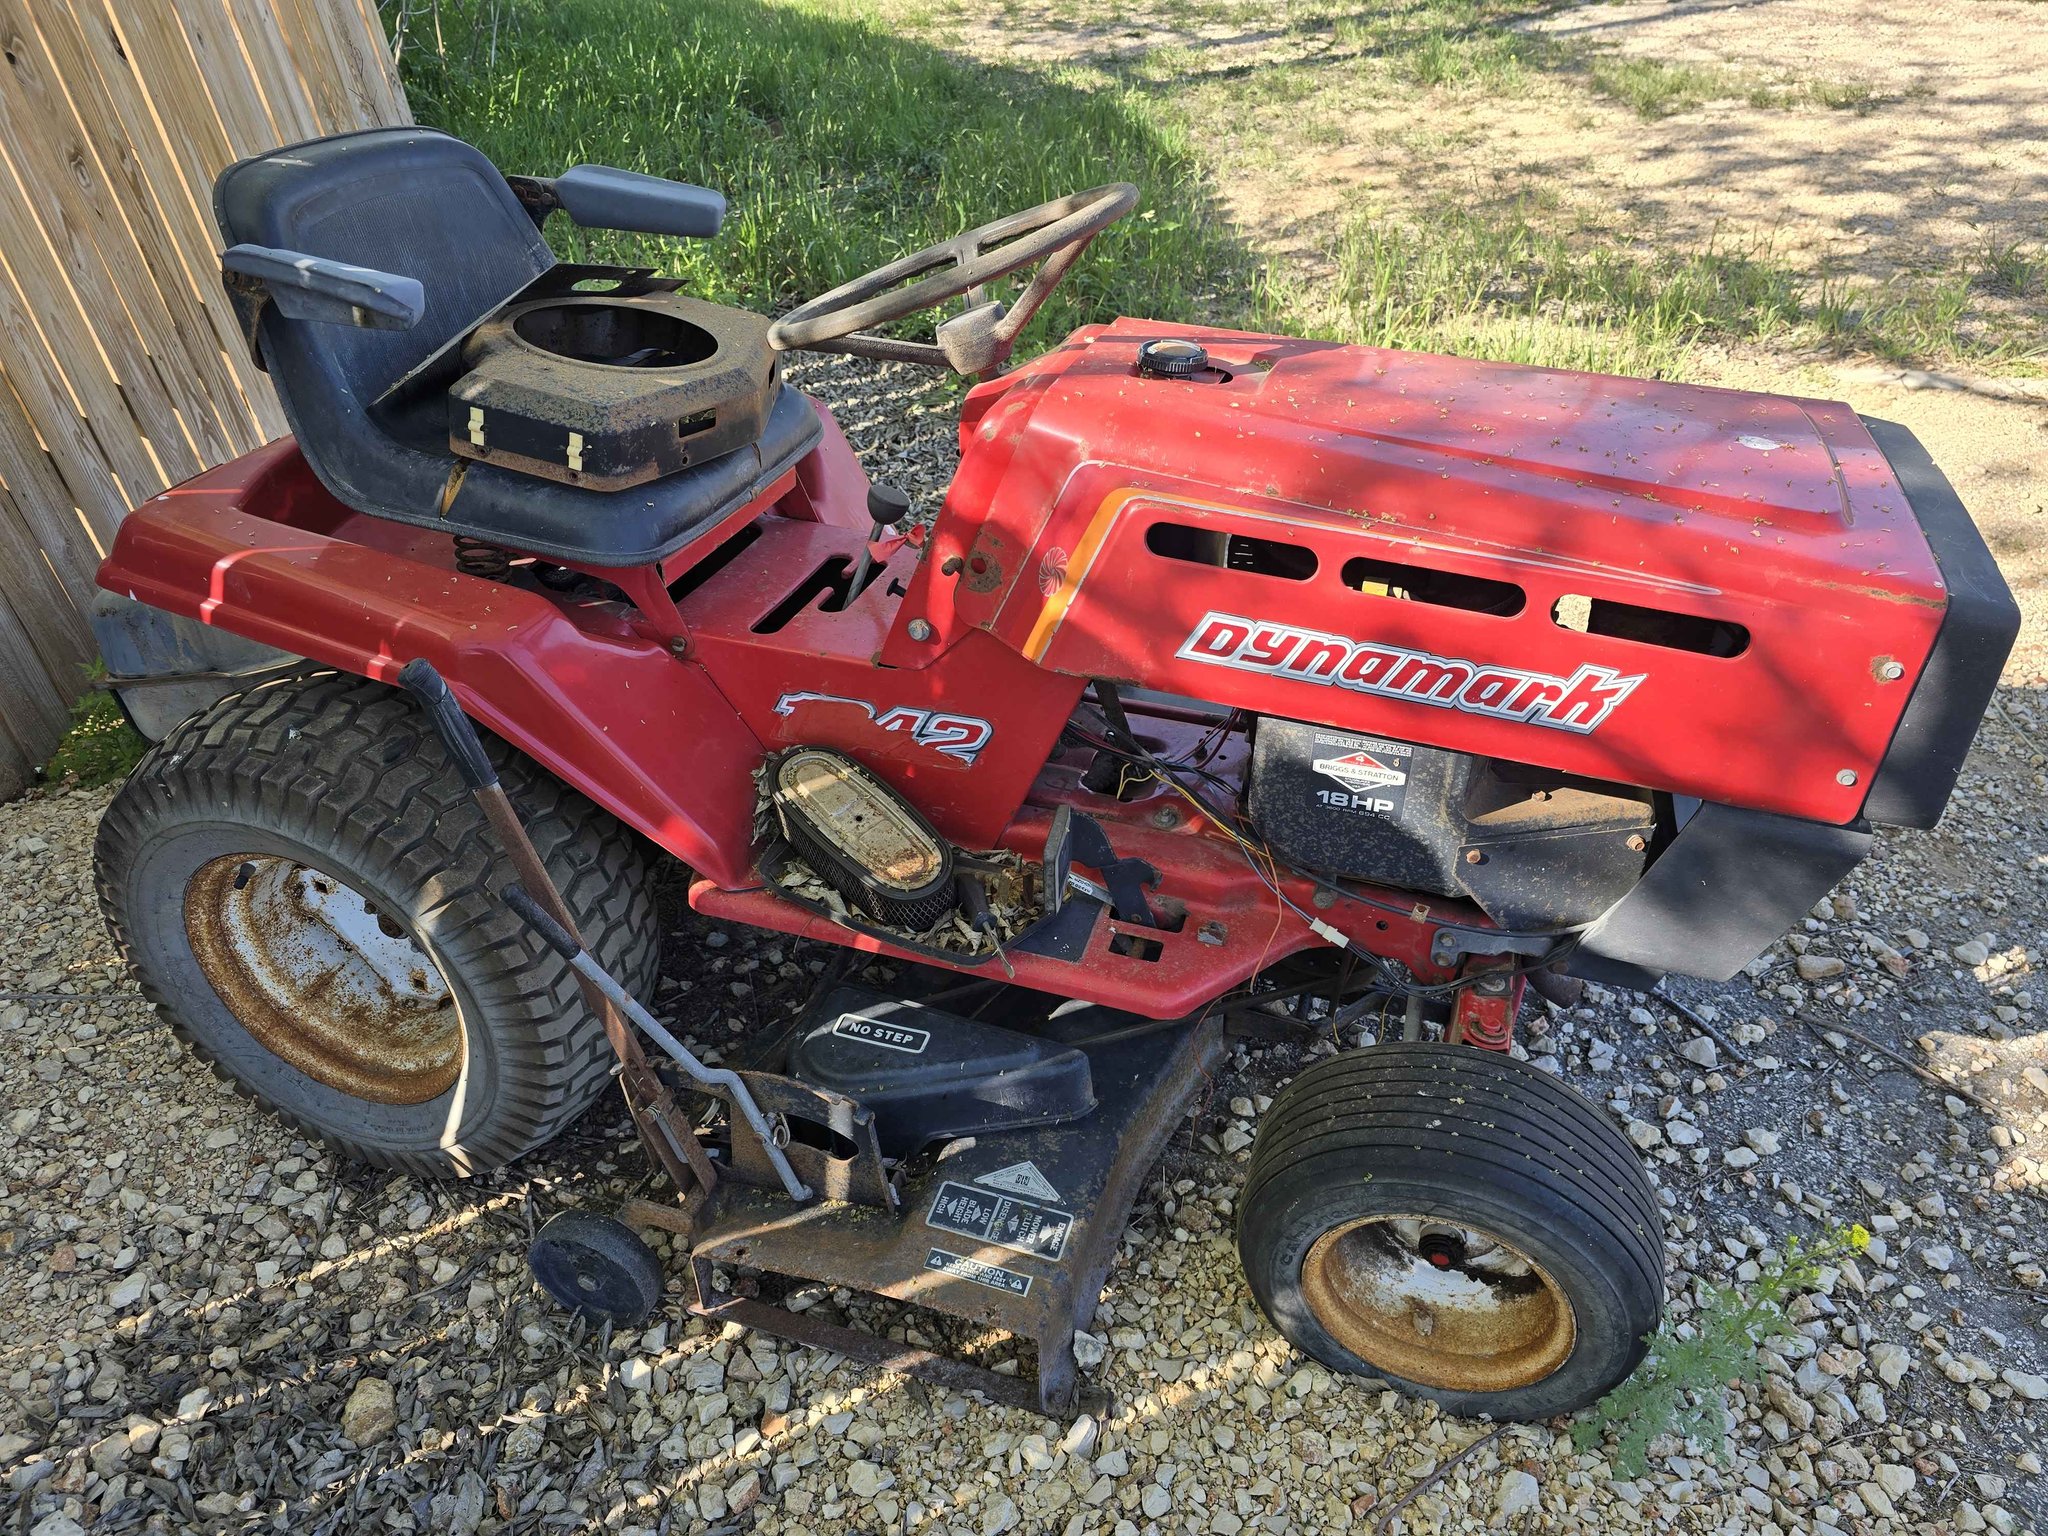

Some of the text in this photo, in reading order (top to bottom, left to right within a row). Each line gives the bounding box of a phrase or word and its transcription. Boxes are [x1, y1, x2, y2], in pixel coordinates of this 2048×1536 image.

[1319, 763, 1349, 774] BRIGGS
[1358, 769, 1399, 781] STRATTON
[849, 1022, 914, 1044] NO STEP
[936, 1196, 949, 1214] HIGH
[952, 1196, 969, 1223] HEIGHT
[961, 1200, 977, 1224] BLADE
[979, 1208, 992, 1225] LOW
[1016, 1213, 1033, 1242] CLUTCH
[1026, 1215, 1043, 1244] MOWER
[1050, 1222, 1067, 1252] ENGAGE
[942, 1267, 960, 1275] AWAY
[960, 1271, 977, 1280] FROM
[954, 1258, 1005, 1278] CAUTION
